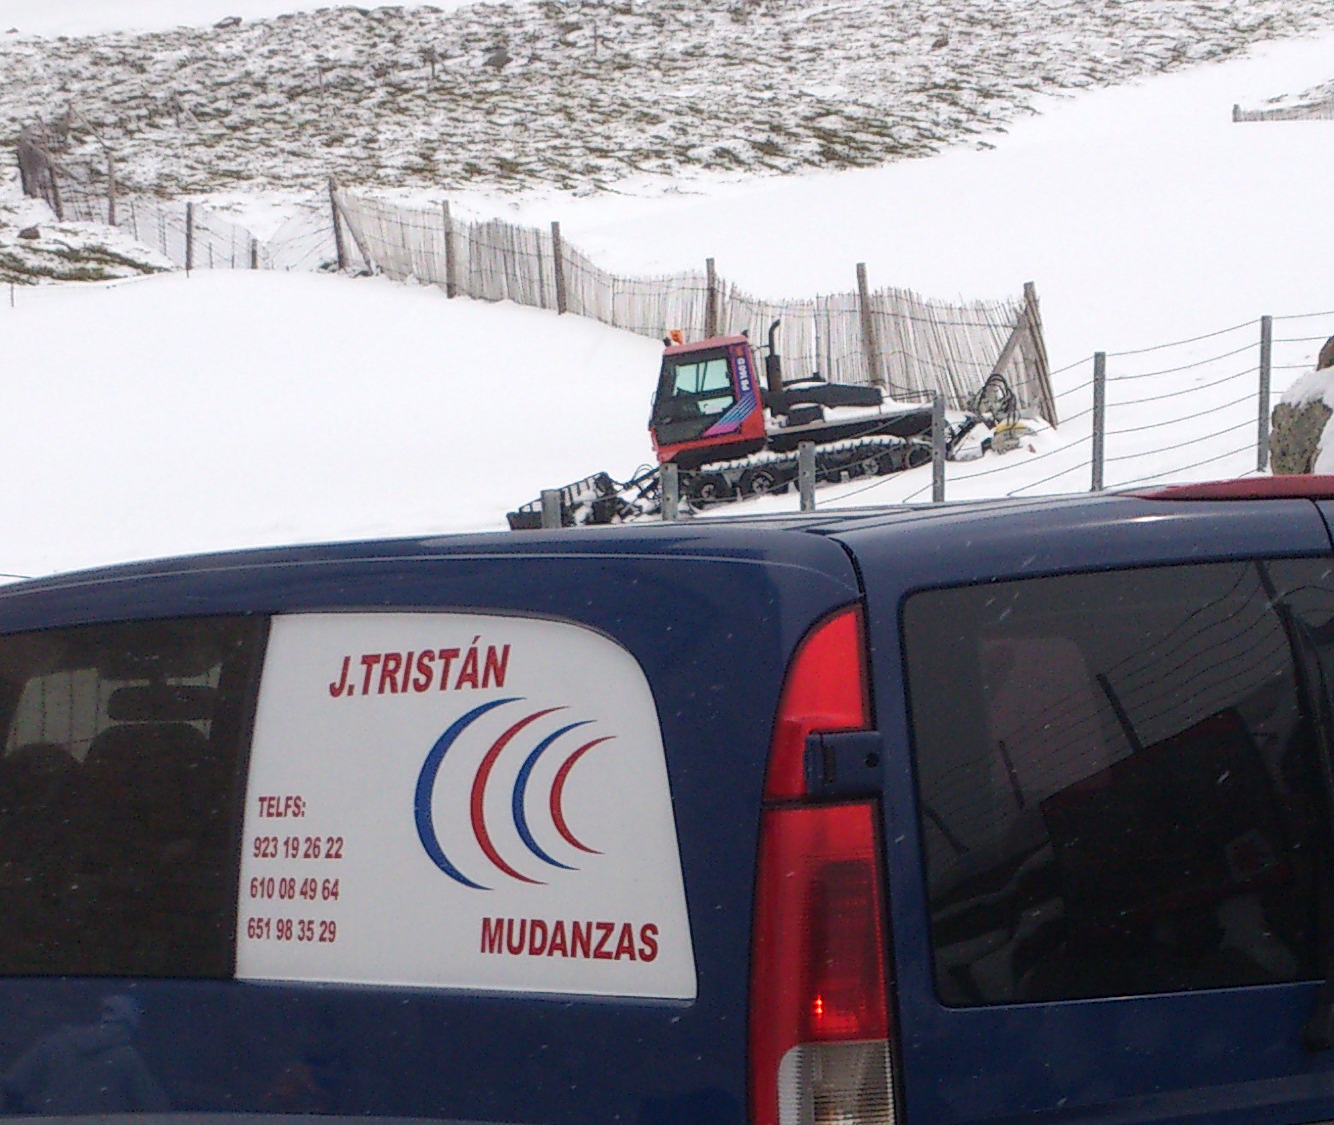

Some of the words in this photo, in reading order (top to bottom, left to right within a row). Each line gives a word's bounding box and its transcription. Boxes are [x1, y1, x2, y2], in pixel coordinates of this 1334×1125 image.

[330, 635, 511, 697] J.TRISTÁN
[258, 795, 306, 818] TELFS:
[253, 836, 278, 859] 923
[283, 836, 300, 859] 19
[303, 836, 322, 859] 26
[325, 836, 344, 859] 22
[250, 876, 275, 899] 610
[279, 877, 296, 900] 08
[300, 878, 318, 900] 49
[321, 878, 340, 901] 64
[247, 917, 271, 940] 651
[276, 918, 293, 941] 98
[297, 919, 315, 942] 35
[318, 920, 337, 943] 29
[480, 916, 660, 963] MUDANZAS
